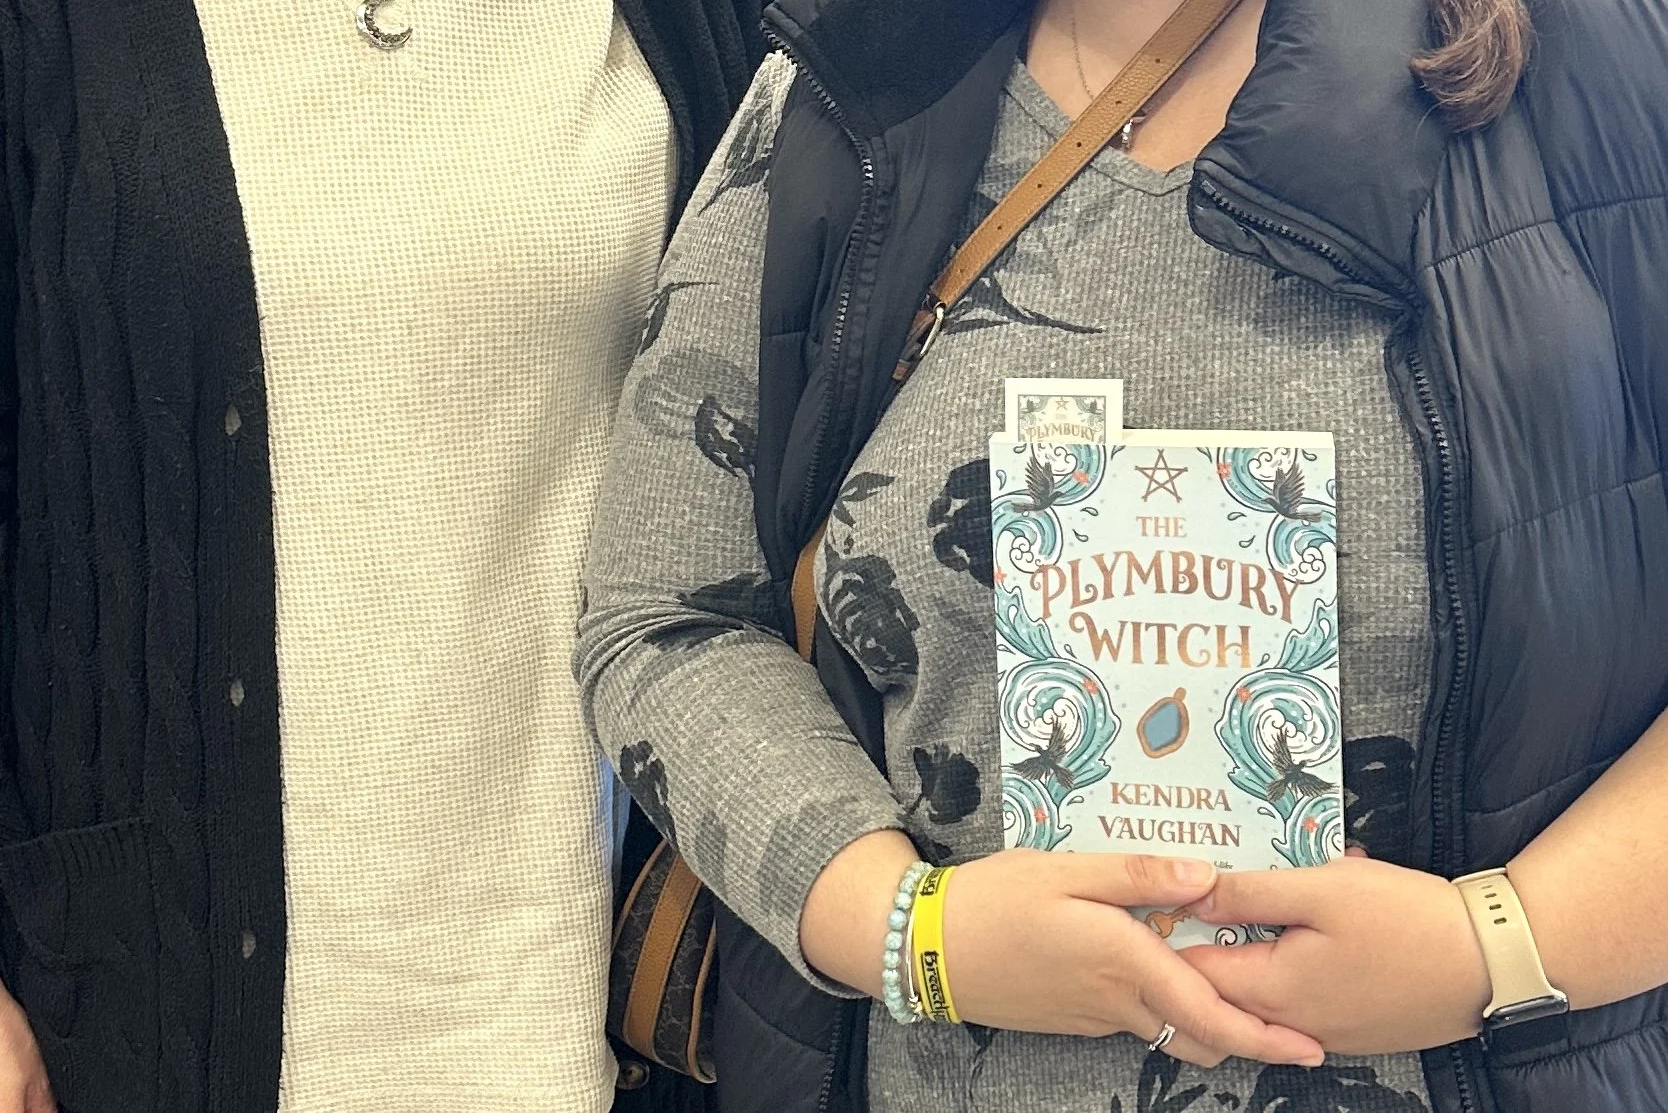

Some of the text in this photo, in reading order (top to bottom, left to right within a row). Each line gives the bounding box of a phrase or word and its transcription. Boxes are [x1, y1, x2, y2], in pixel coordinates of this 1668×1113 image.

[1026, 422, 1099, 443] PLYMBURY
[1135, 516, 1188, 539] THE
[1029, 549, 1303, 625] PLYMBURY
[1068, 611, 1254, 670] WITCH
[1110, 782, 1233, 813] KENDRA
[1098, 815, 1243, 848] VAUGHAN
